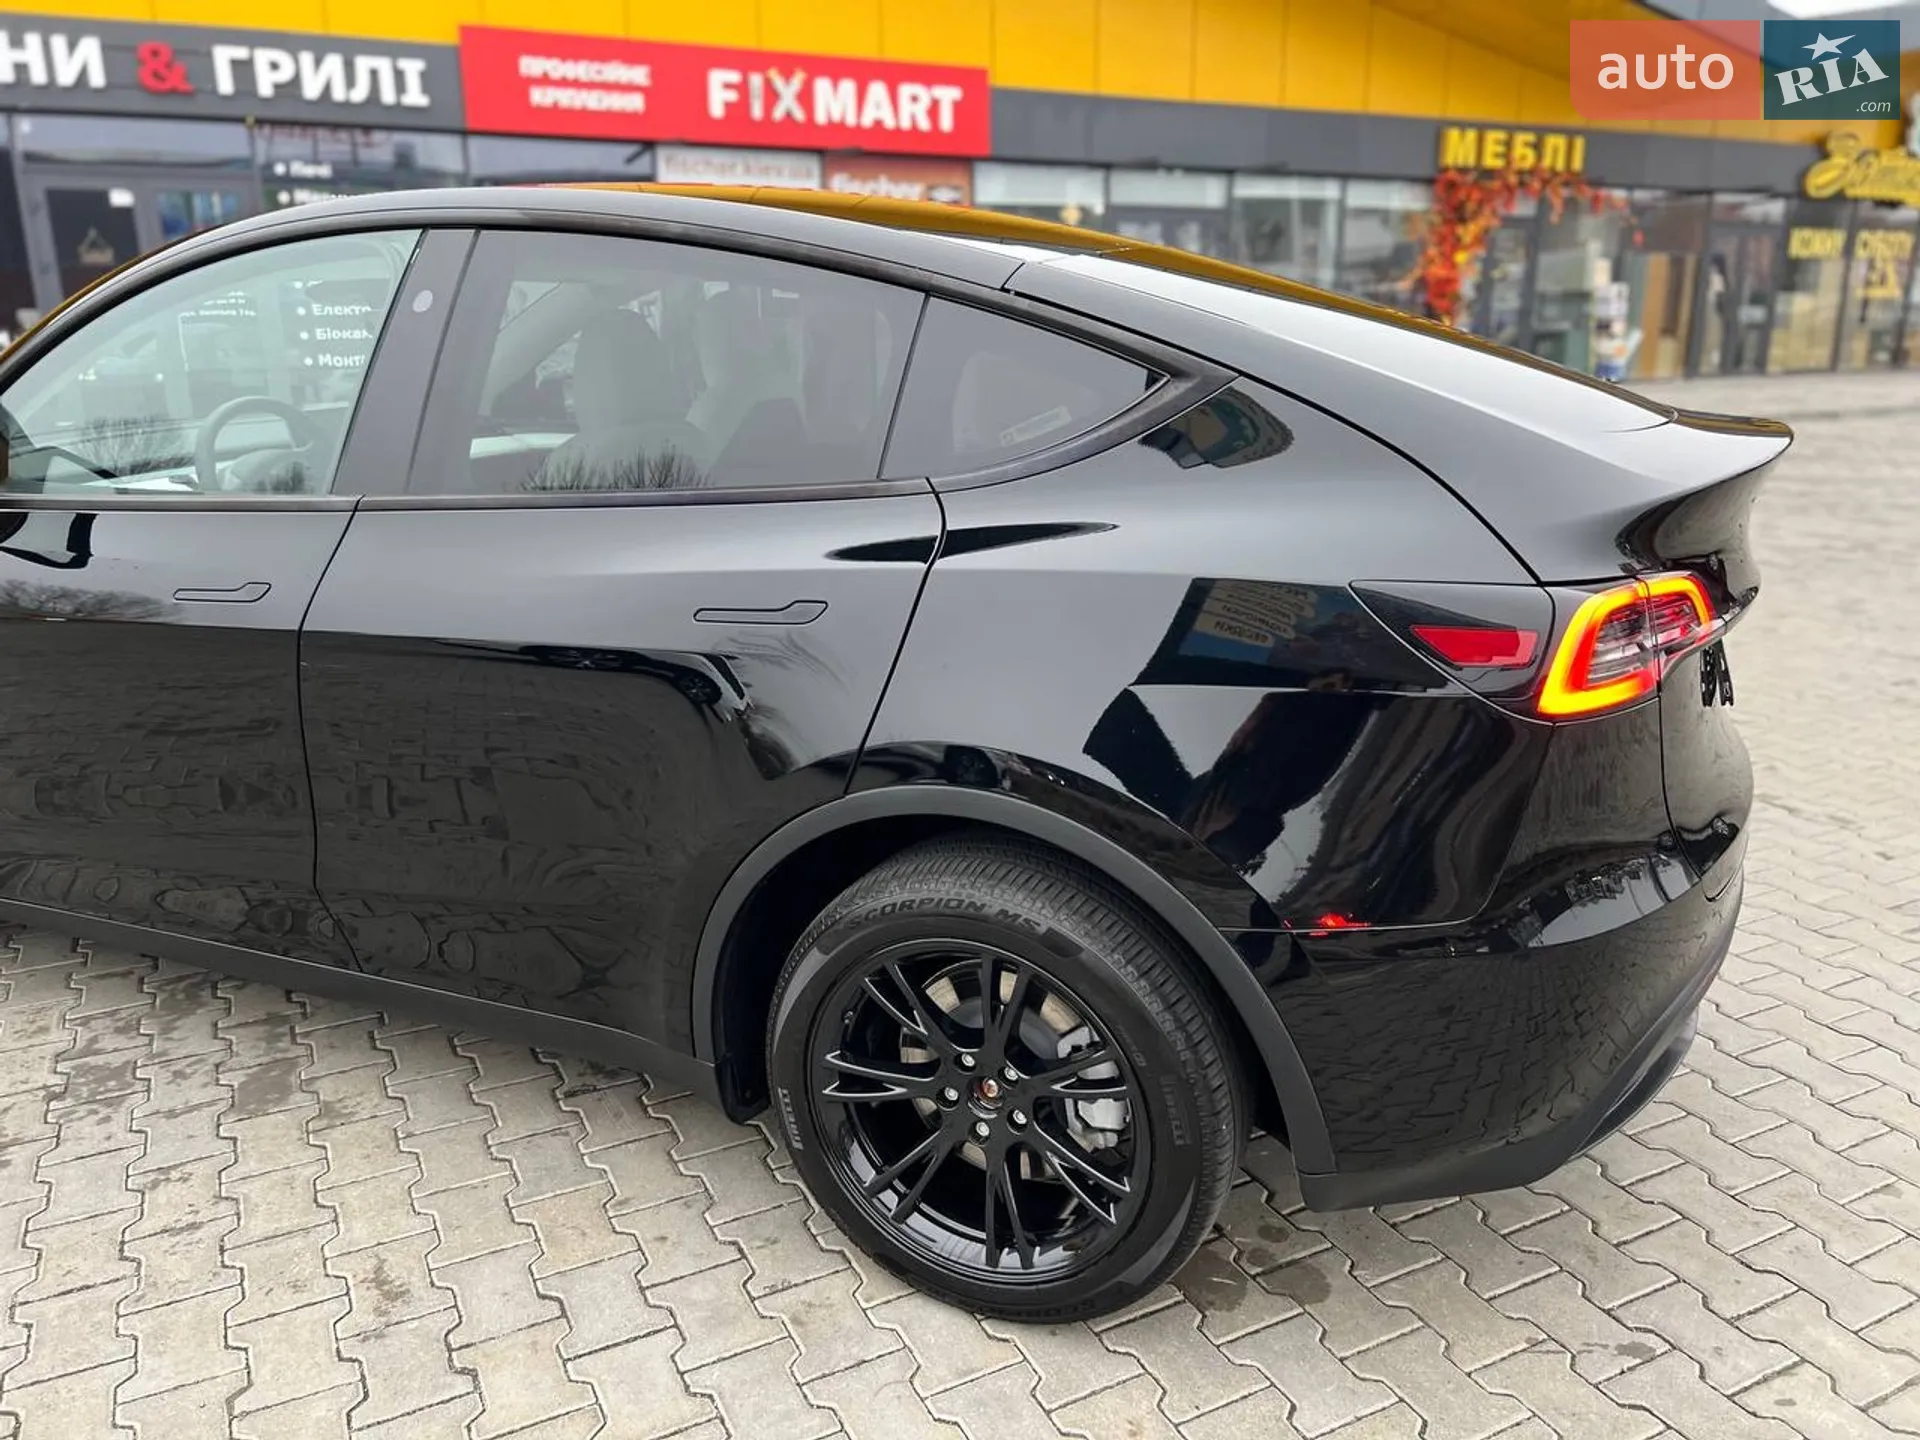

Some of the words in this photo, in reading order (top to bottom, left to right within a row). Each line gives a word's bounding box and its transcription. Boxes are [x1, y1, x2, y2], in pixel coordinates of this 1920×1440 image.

[0, 29, 106, 88] НИ
[136, 41, 194, 94] &
[211, 44, 430, 107] ГРИЛІ
[1442, 126, 1587, 173] МЕБЛІ
[317, 352, 366, 368] Монт
